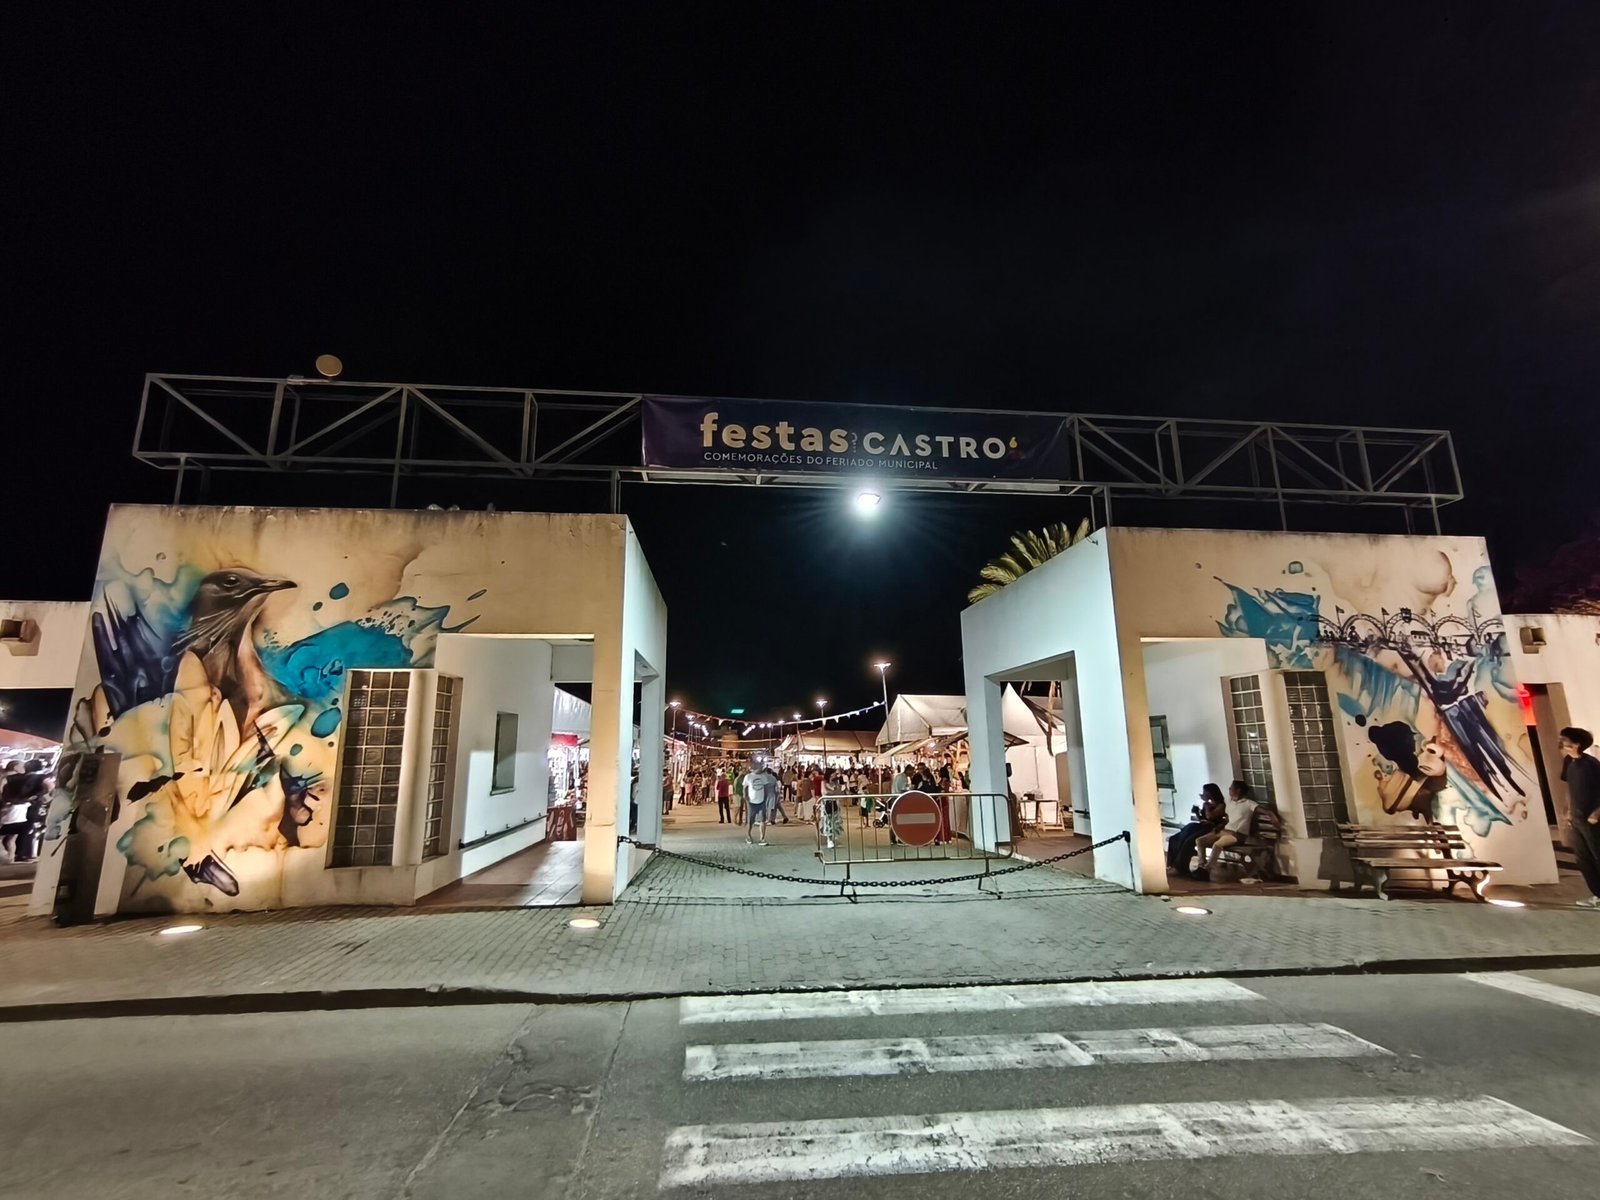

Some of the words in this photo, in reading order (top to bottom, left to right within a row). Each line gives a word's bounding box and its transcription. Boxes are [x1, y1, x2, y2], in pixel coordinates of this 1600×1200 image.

[700, 412, 849, 453] festas
[703, 452, 803, 464] COMEMORAÇÕES
[807, 456, 824, 465] DO
[826, 456, 874, 467] FERIADO
[879, 459, 938, 470] MUNICIPAL
